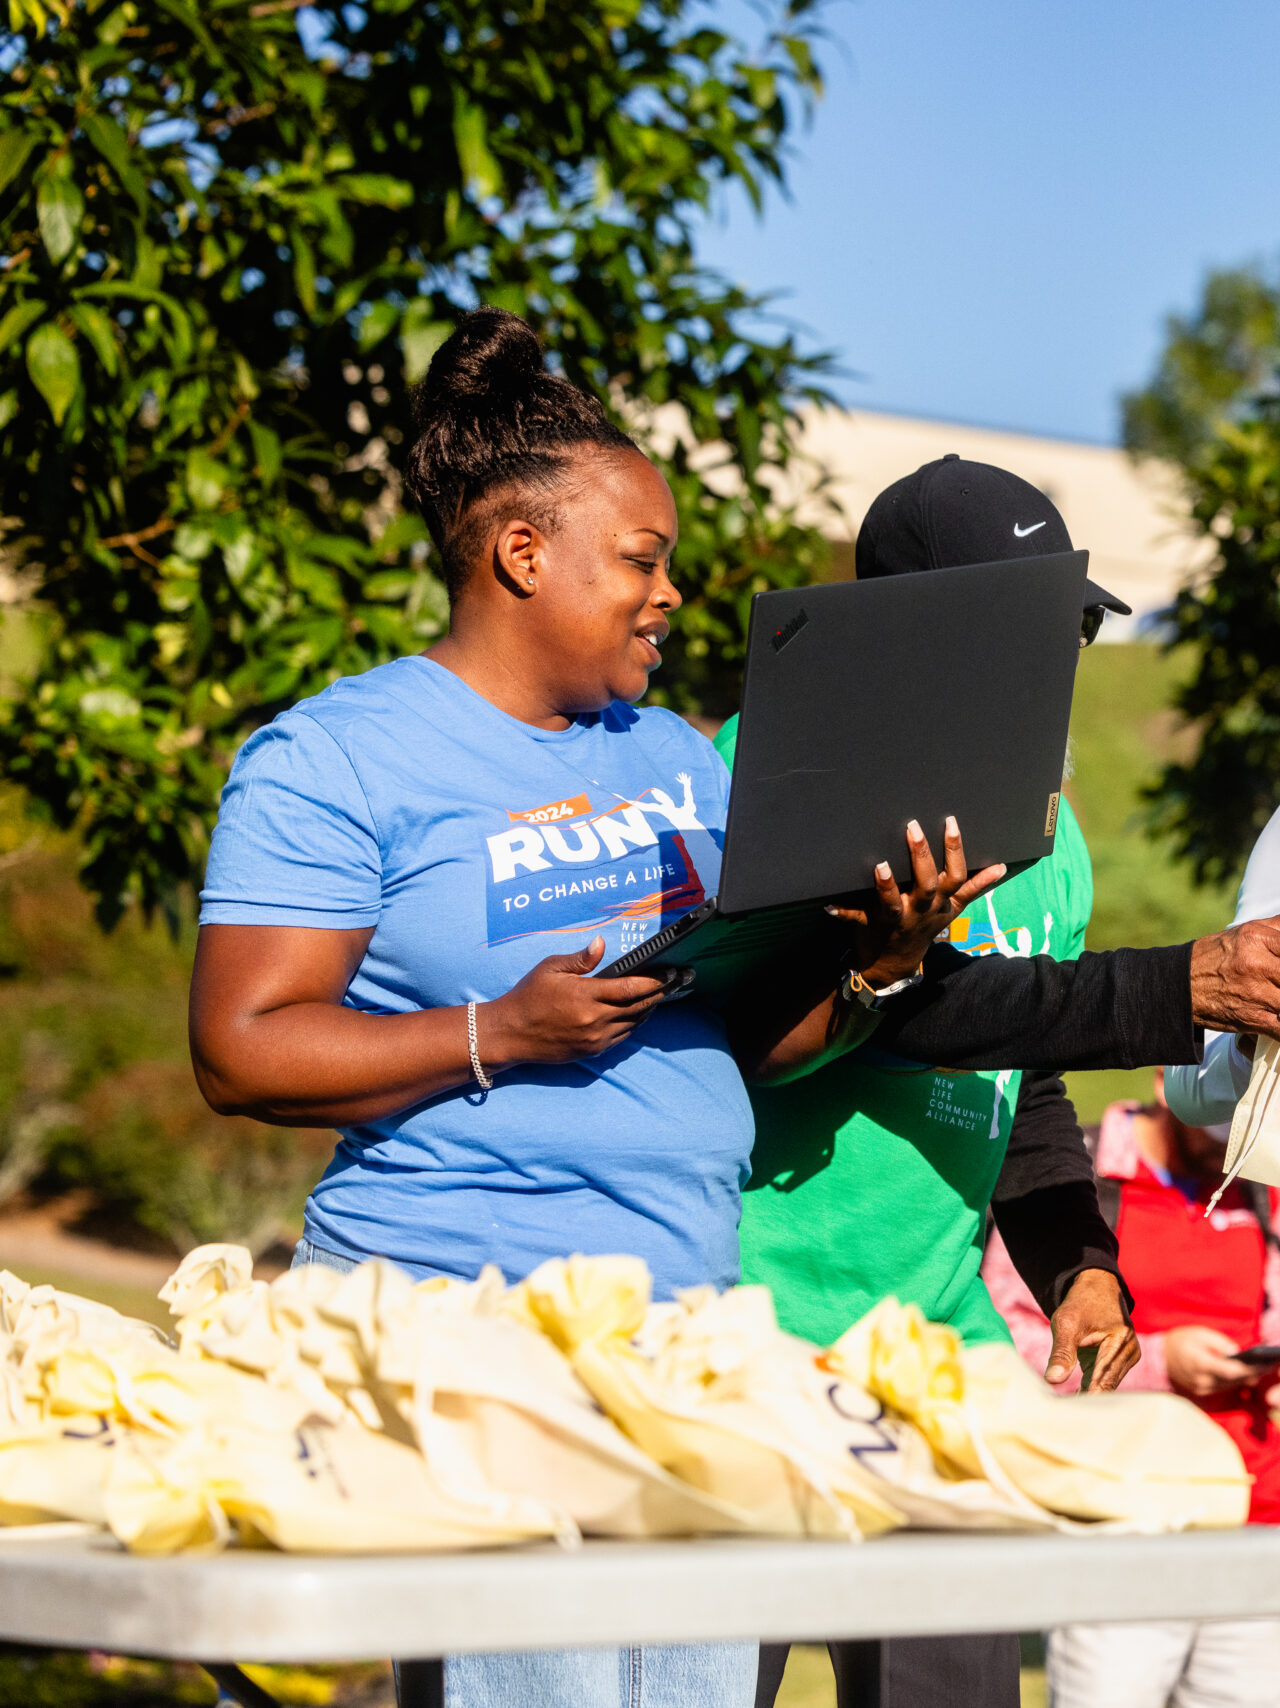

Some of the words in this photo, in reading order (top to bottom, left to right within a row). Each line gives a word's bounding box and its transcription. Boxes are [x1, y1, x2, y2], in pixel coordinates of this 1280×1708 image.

[524, 802, 574, 823] 2024
[1047, 796, 1057, 833] Lenovo
[486, 806, 660, 884] RUN
[503, 894, 530, 912] TO
[538, 878, 618, 902] CHANGE
[625, 871, 637, 886] A
[644, 863, 676, 881] LIFE
[622, 921, 648, 931] NEW
[621, 933, 645, 943] LIFE
[931, 1088, 952, 1100] LIFE
[934, 1077, 954, 1090] NEW
[925, 1109, 977, 1131] ALLIANCE
[929, 1098, 988, 1122] COMMUNITY
